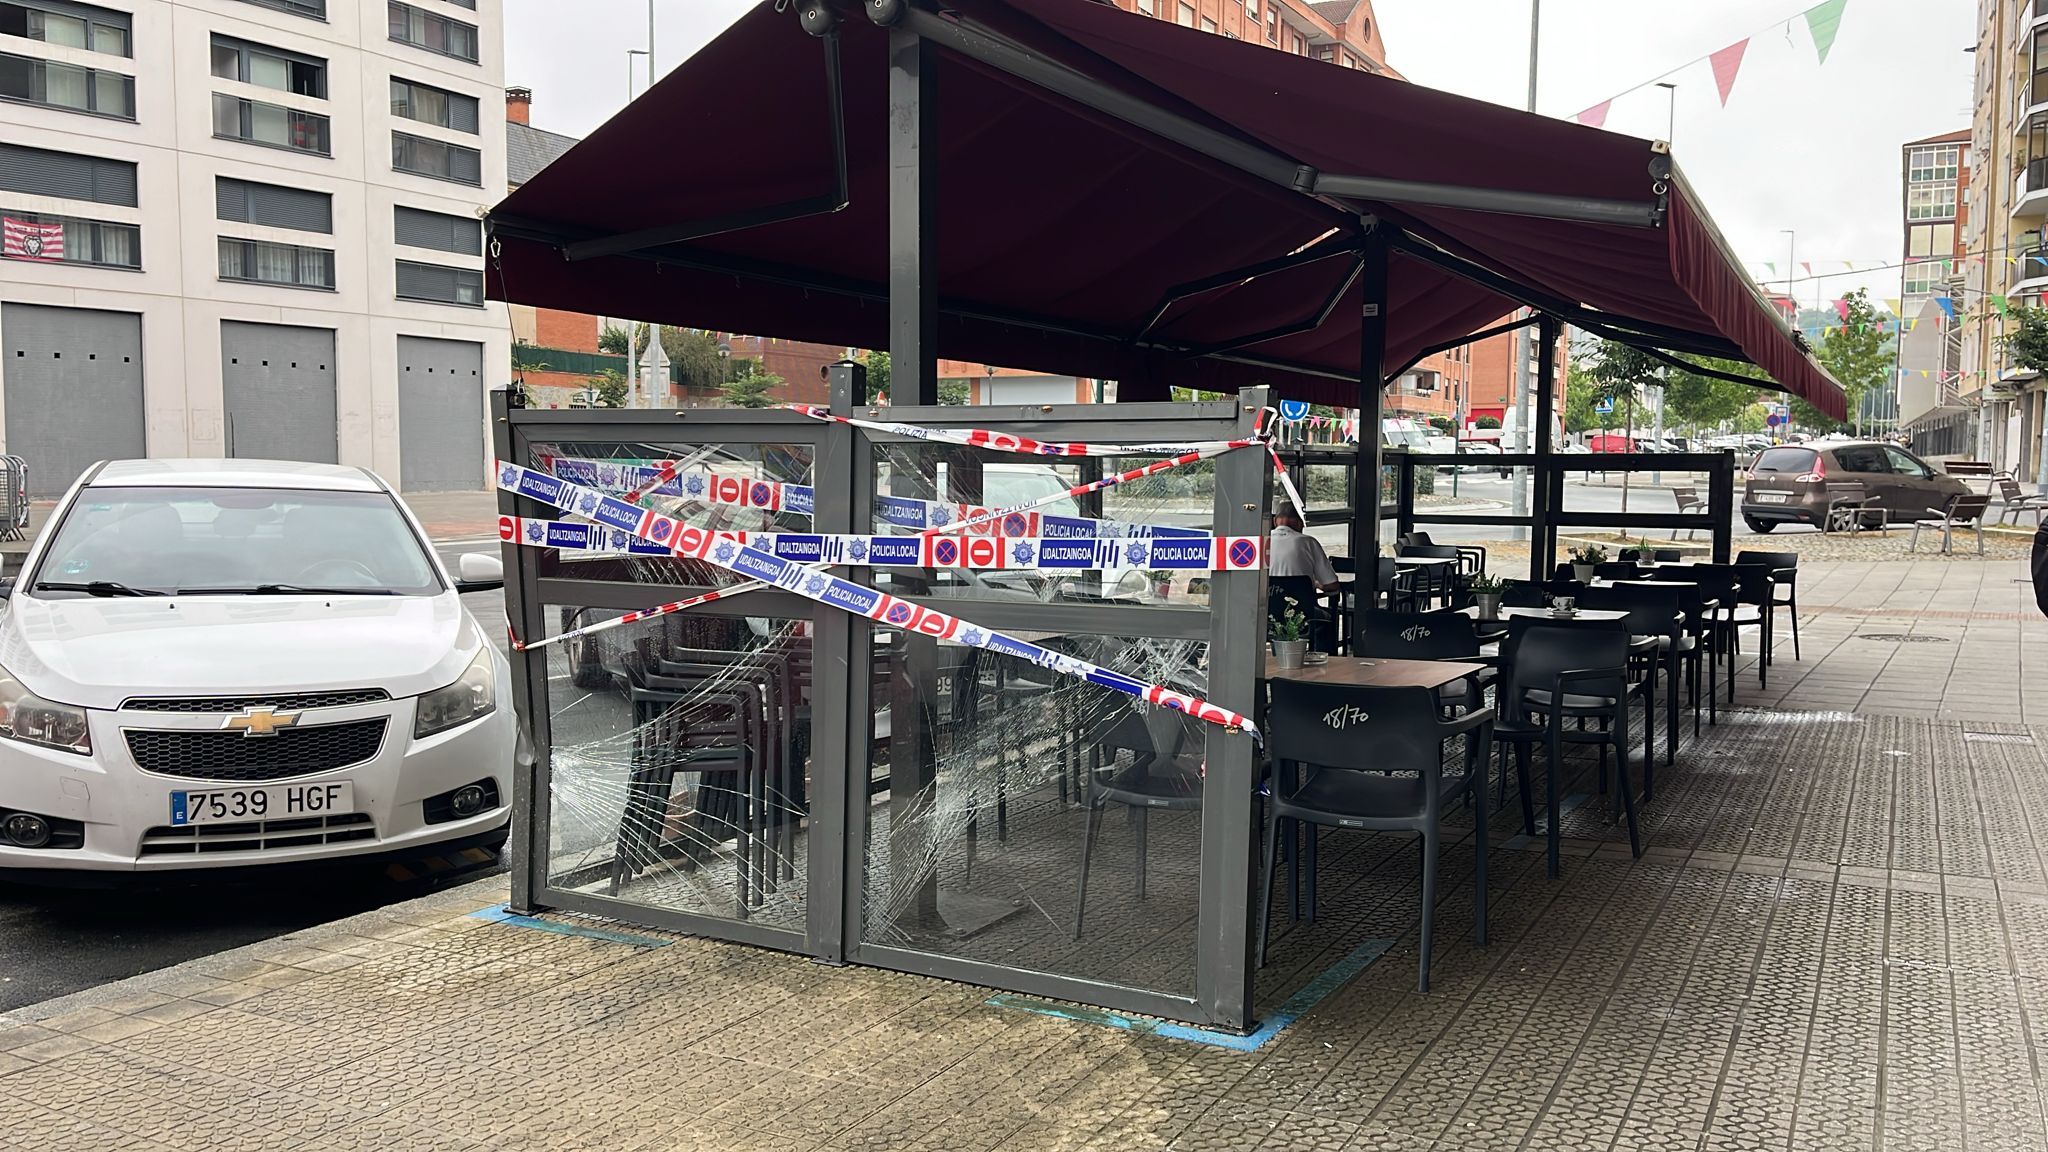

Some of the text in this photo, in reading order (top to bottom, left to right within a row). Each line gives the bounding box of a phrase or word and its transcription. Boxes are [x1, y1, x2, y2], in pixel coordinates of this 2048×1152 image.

[522, 478, 557, 498] UDALTZAINGOA
[599, 504, 638, 526] POLICIA LOCAL
[549, 528, 587, 542] UDALTZAINGOA
[1044, 524, 1070, 538] POLICIA
[777, 542, 918, 558] UDALTZAINGOA POLICIA LOCAL
[1042, 547, 1208, 560] UDALTZAINGOA POLICIA LOCAL
[738, 554, 872, 609] UDALTZAINGOA POLICIA LOCAL
[1400, 624, 1431, 642] 18/70
[1322, 704, 1369, 729] 18/70
[189, 784, 342, 821] 7539 HGF
[176, 811, 183, 820] E
